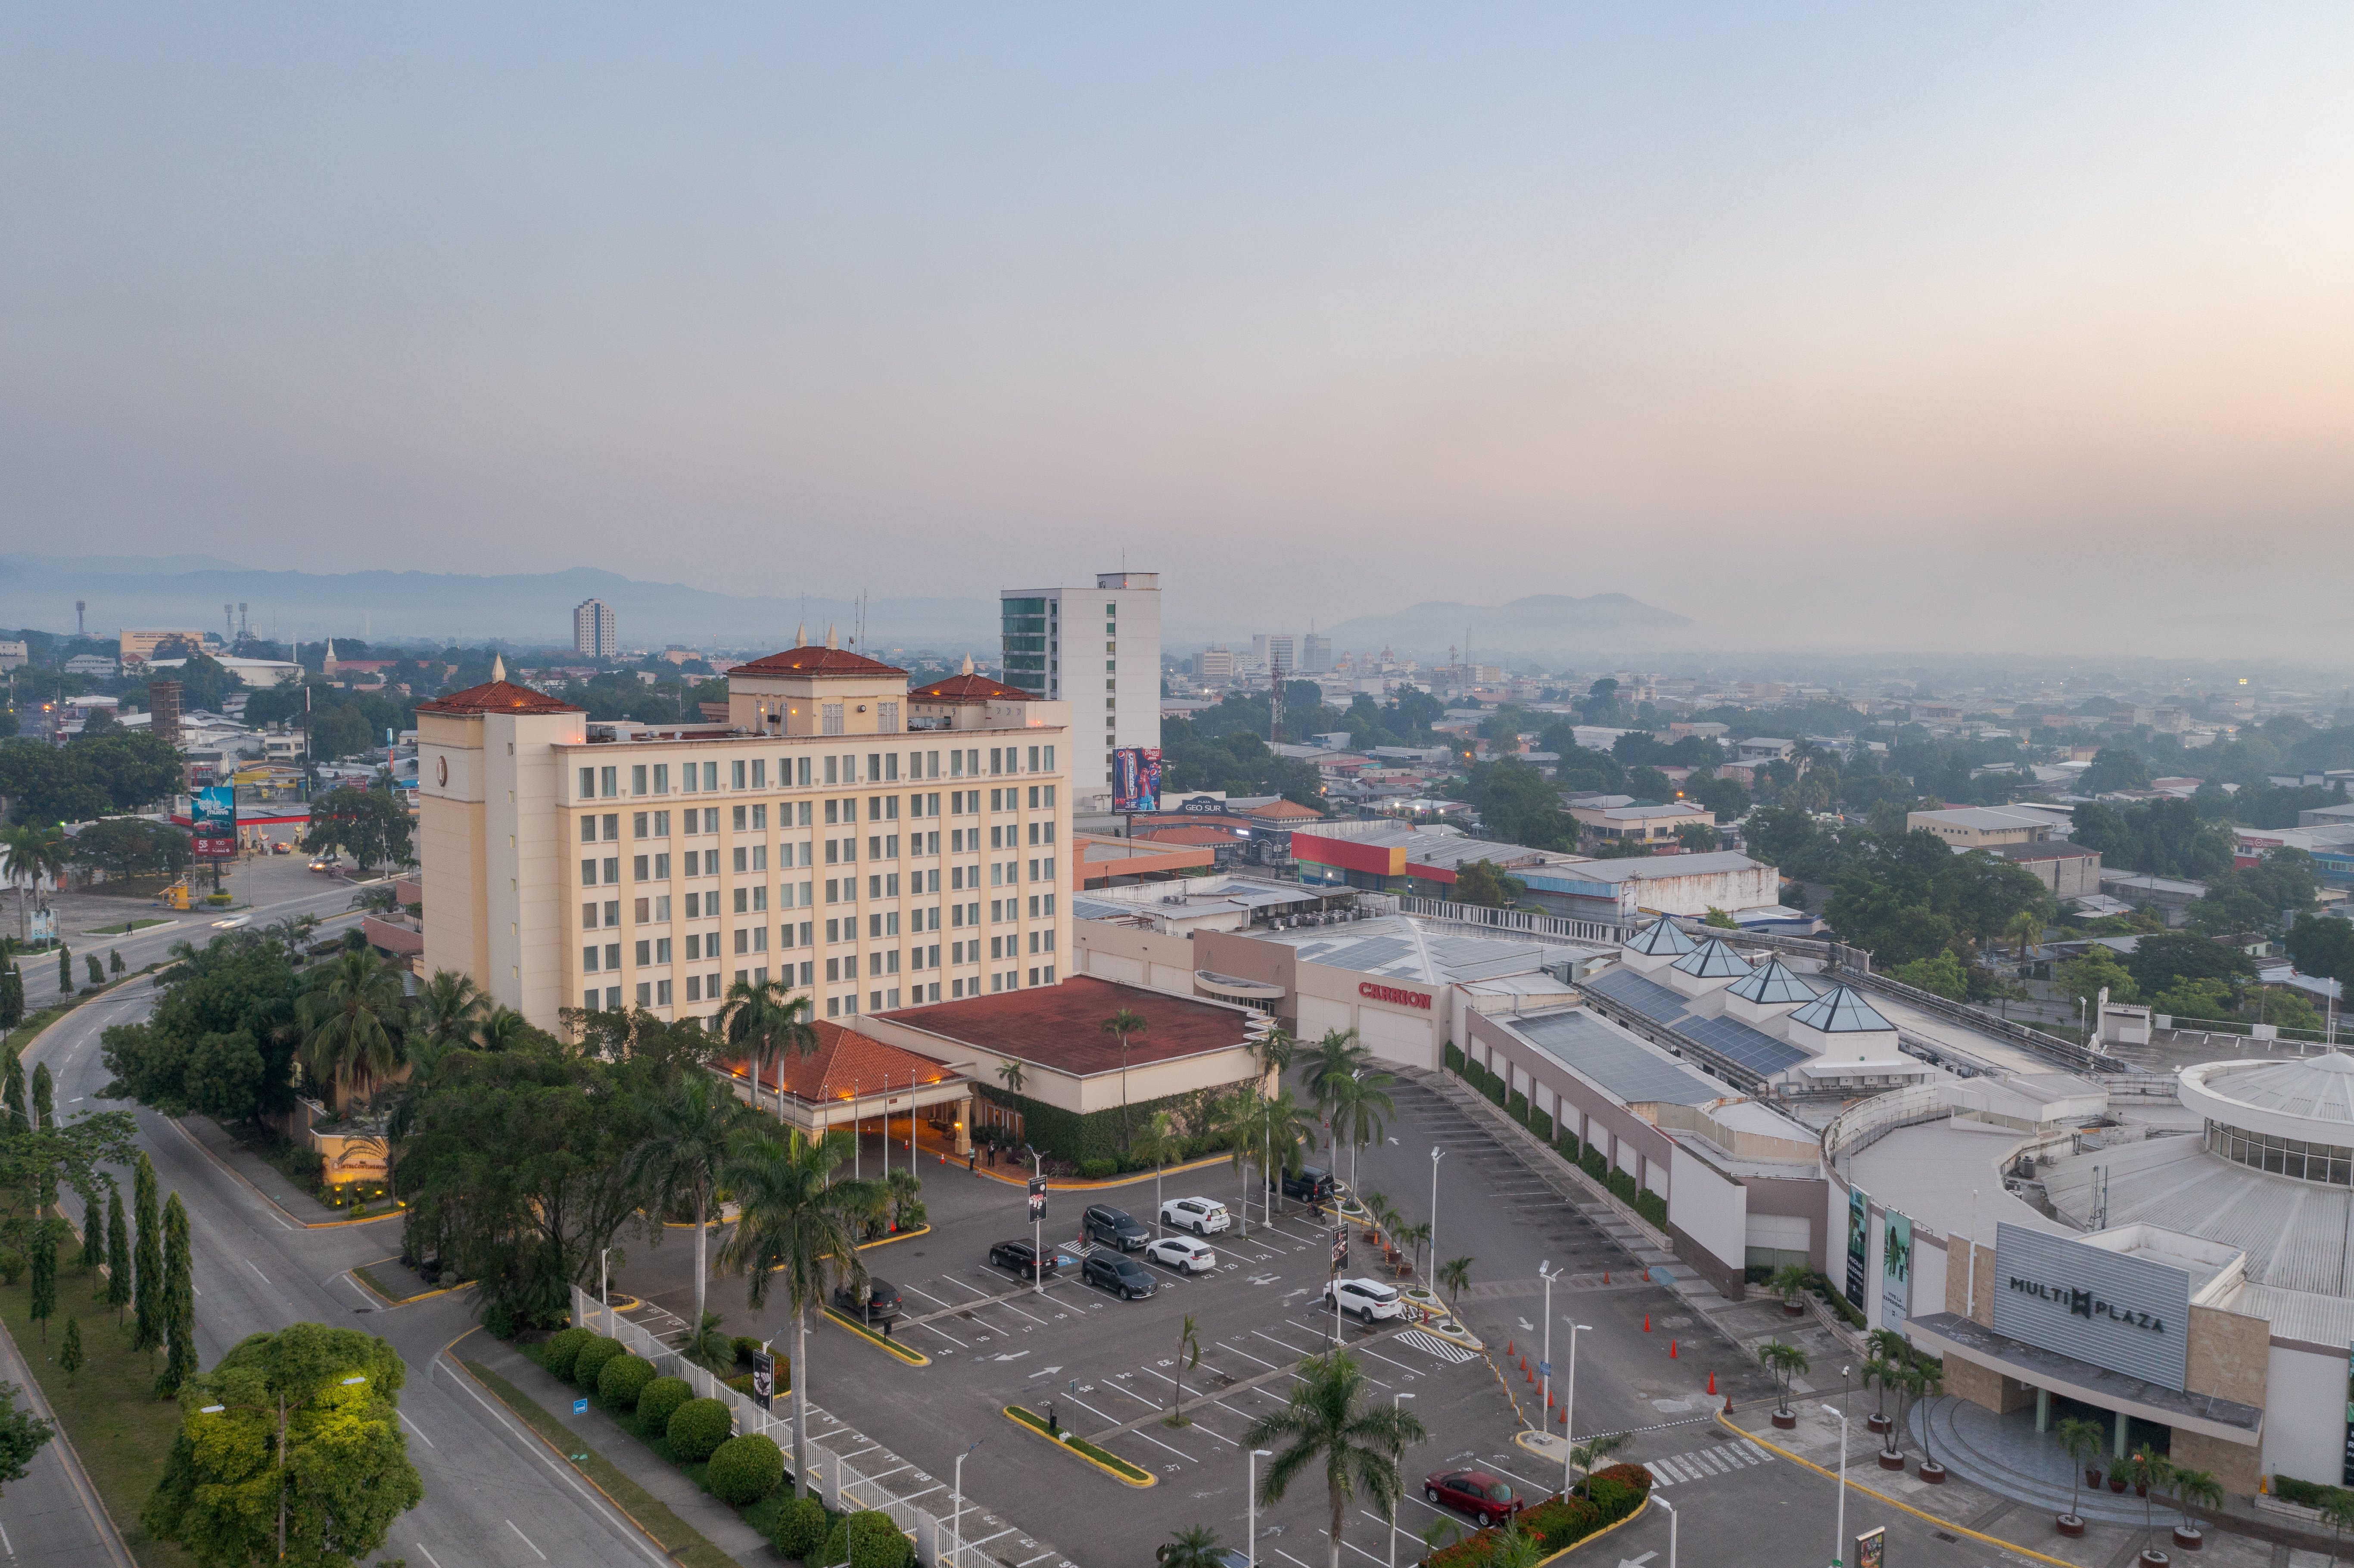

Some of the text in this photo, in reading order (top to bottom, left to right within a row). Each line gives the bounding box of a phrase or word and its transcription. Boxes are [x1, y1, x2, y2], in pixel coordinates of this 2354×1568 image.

[1638, 907, 1662, 917] DRUGSTORE
[1358, 982, 1432, 1009] CARRION
[1849, 1255, 1863, 1270] MUCHAS
[1847, 1263, 1863, 1279] RAZONES
[1888, 1291, 1896, 1300] VIVE
[1883, 1295, 1906, 1312] EXPERIENCIA
[2010, 1276, 2164, 1333] MULTI PLAZA
[852, 1434, 869, 1442] 62
[914, 1472, 932, 1481] 60
